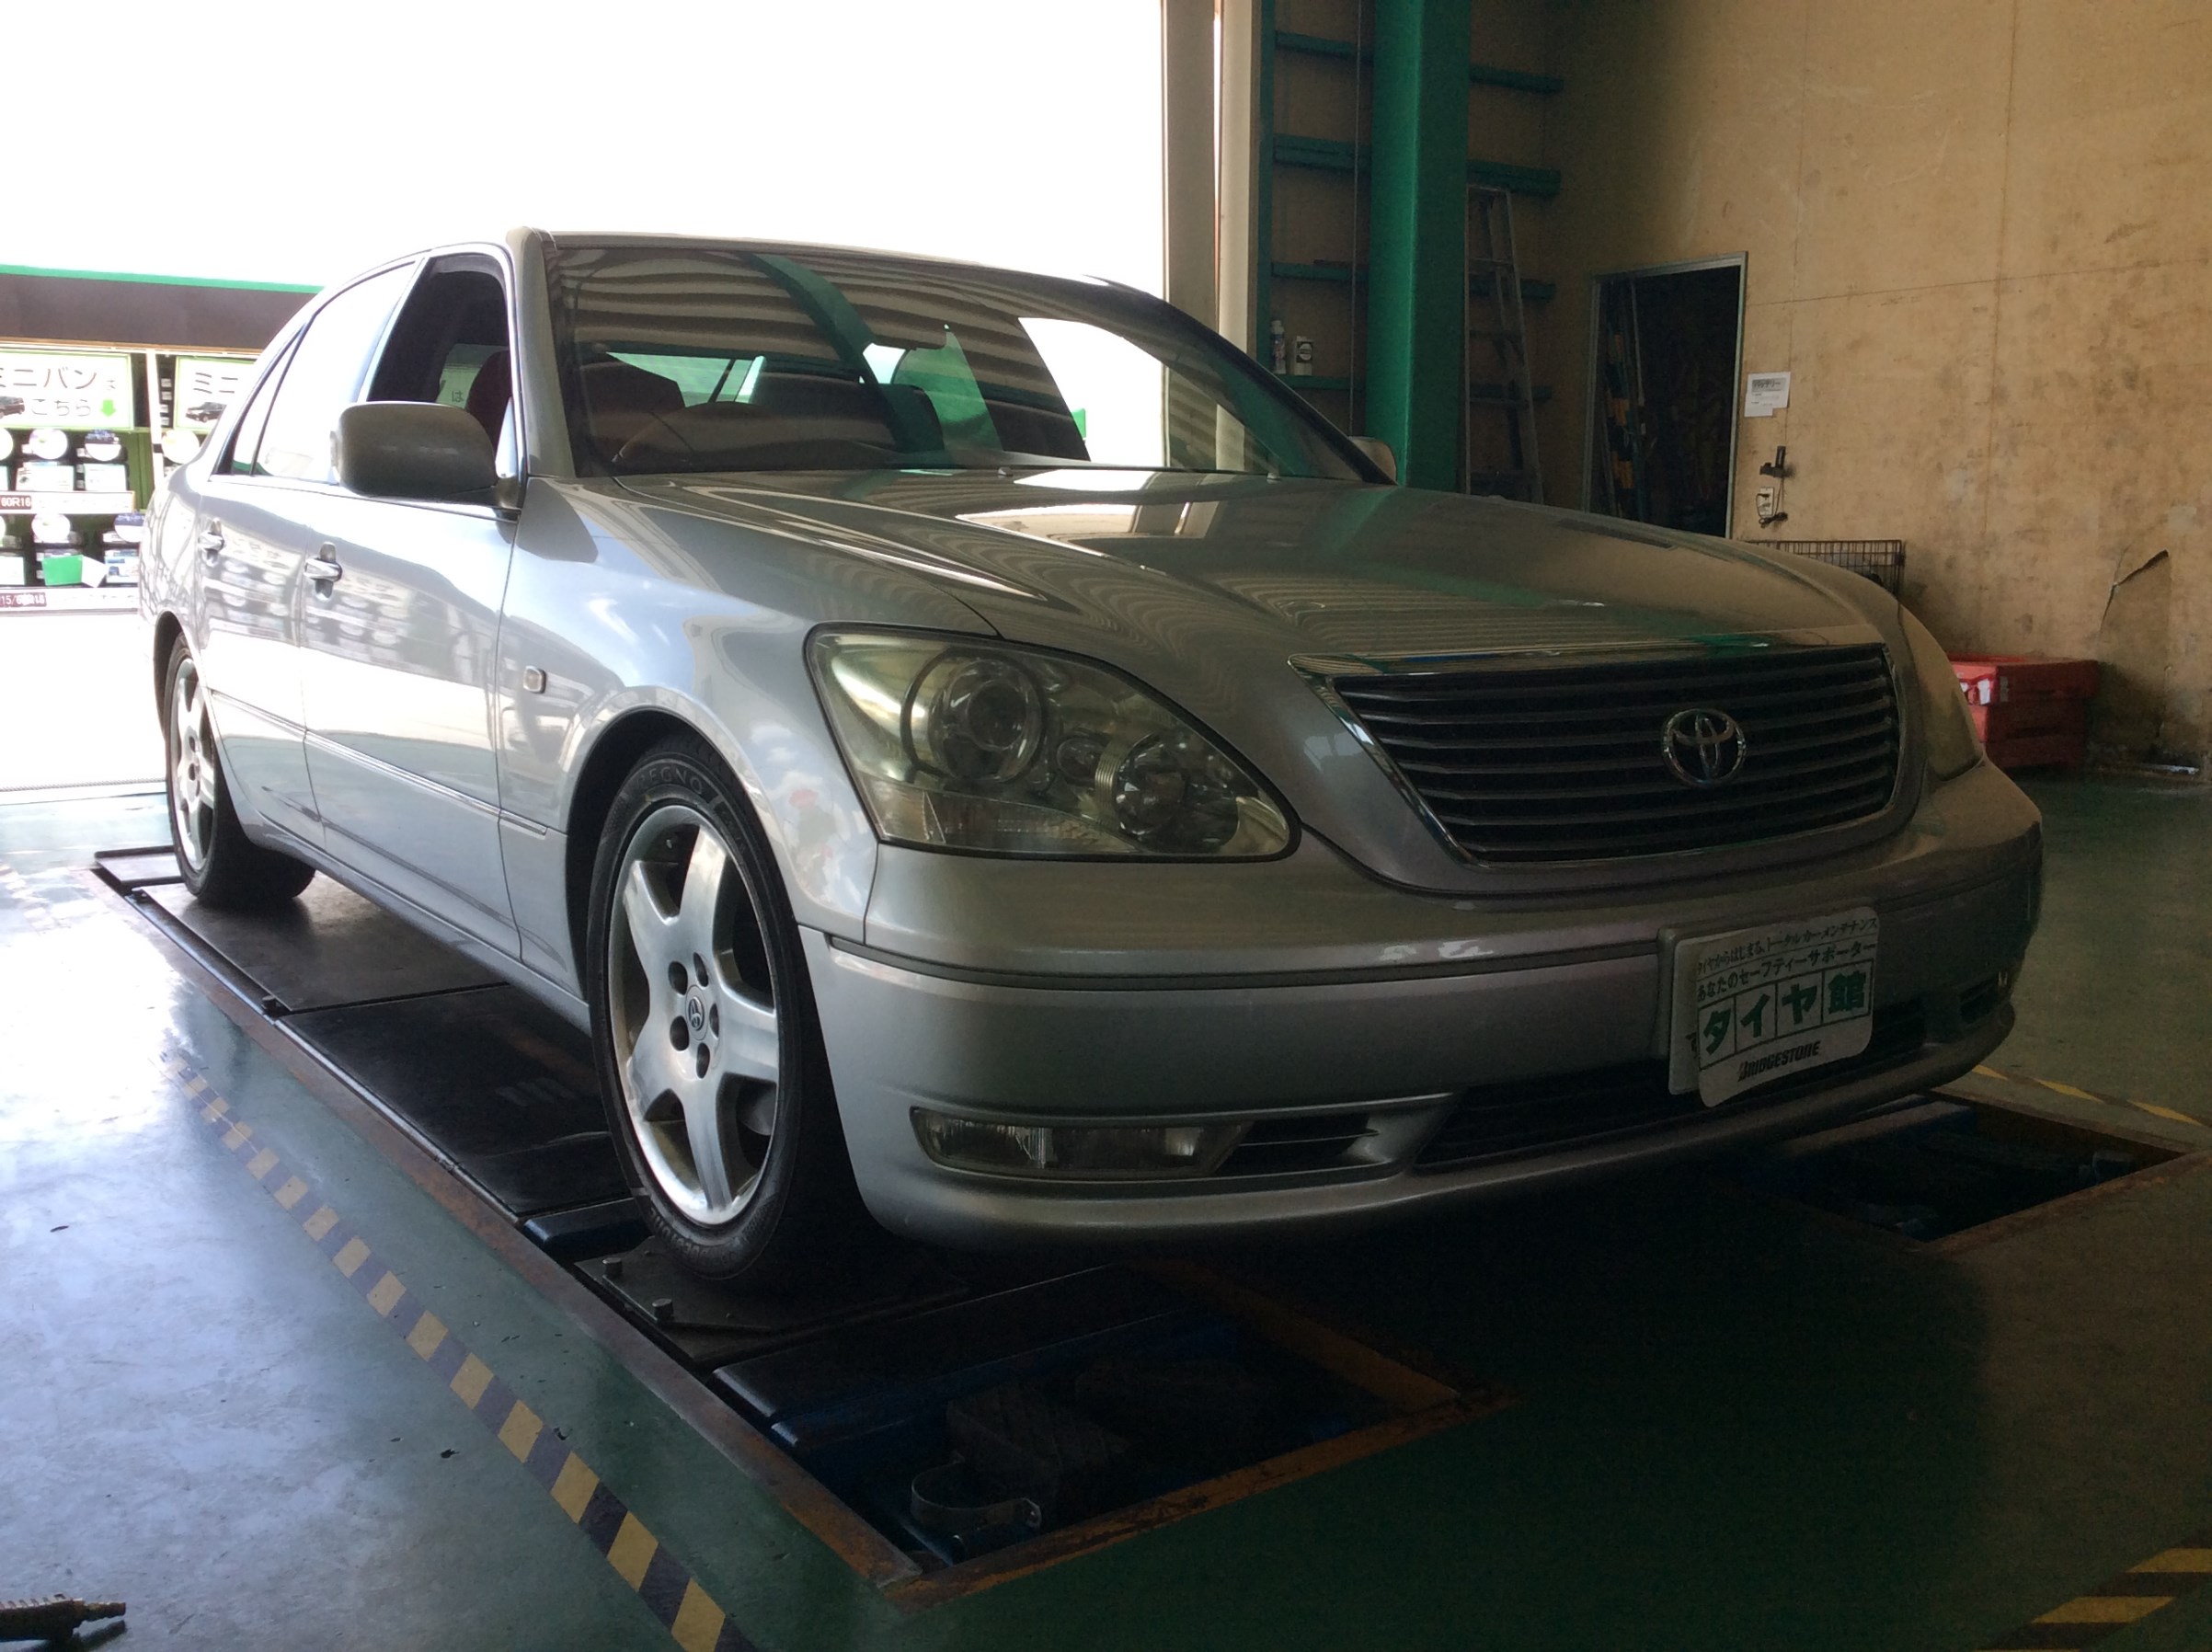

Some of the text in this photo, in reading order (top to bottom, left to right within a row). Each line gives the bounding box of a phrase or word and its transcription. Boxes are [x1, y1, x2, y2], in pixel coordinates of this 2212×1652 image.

[30, 397, 92, 417] こちら
[1697, 940, 1876, 1003] あなたのセーフティーサポーター
[1702, 969, 1867, 1056] タイヤ館
[1737, 1040, 1821, 1082] BRIDGESTONE
